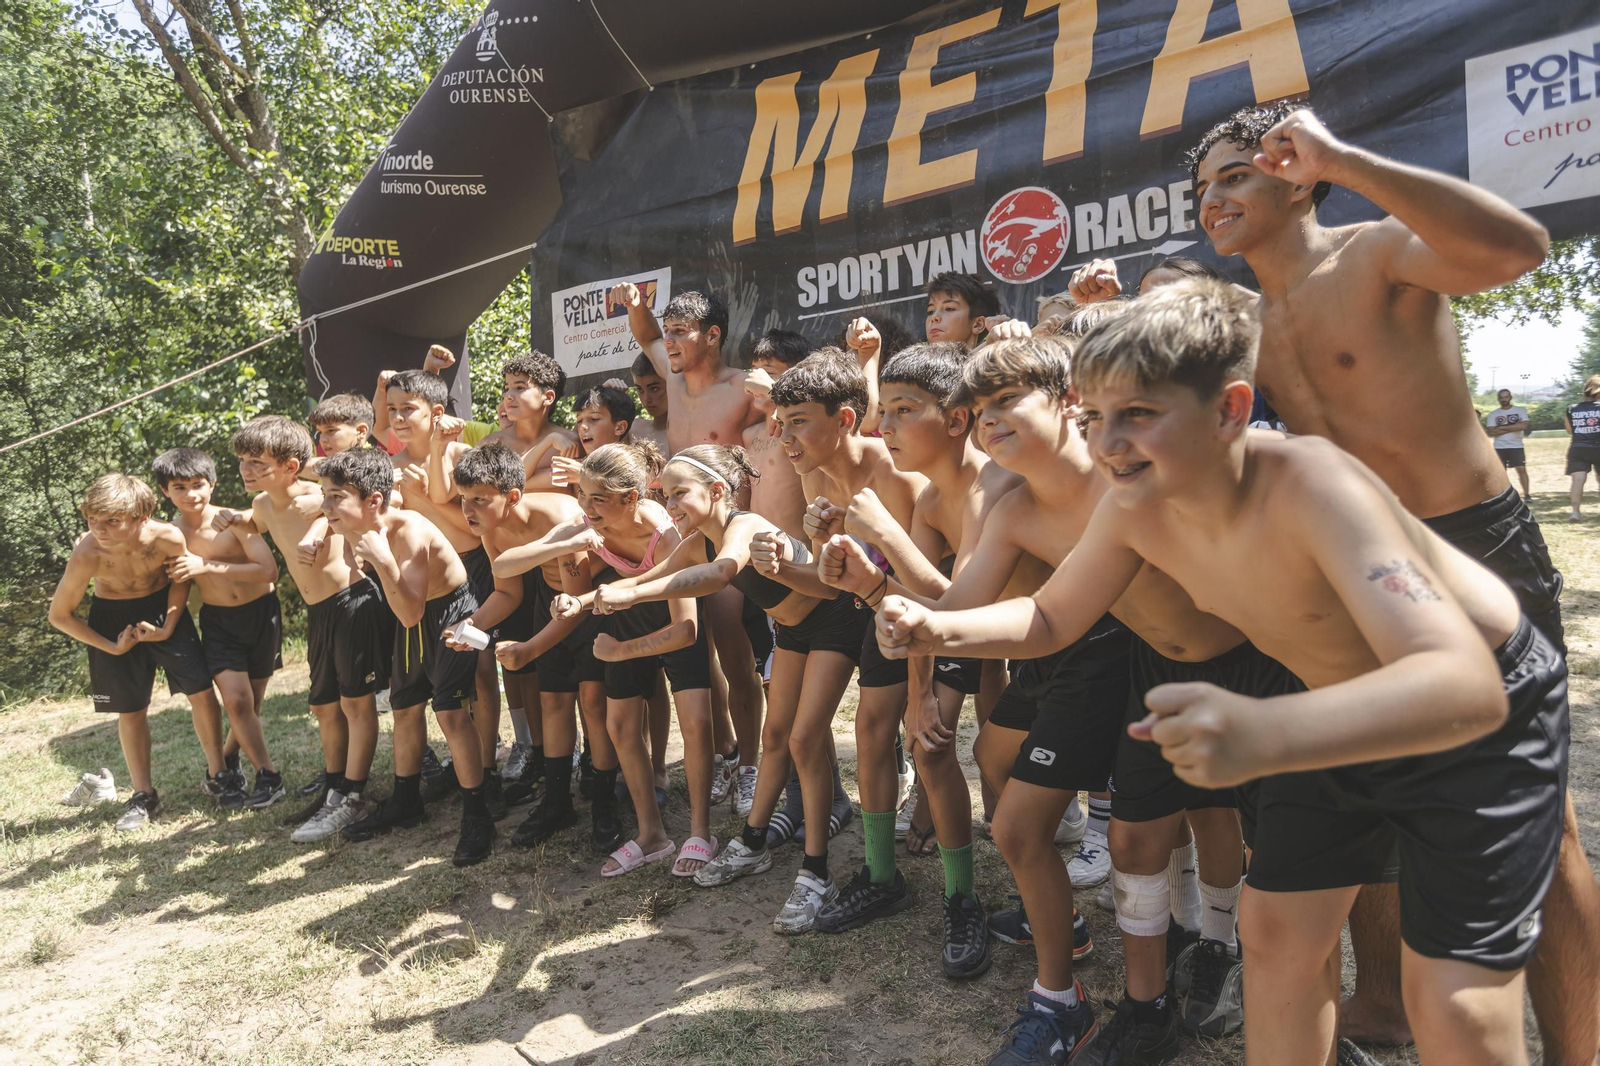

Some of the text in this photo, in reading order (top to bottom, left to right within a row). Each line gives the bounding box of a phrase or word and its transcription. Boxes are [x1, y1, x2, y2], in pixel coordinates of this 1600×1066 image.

[441, 64, 544, 87] DEPUTACIÓN
[449, 87, 531, 104] OURENSE
[732, 0, 1310, 247] META
[1504, 118, 1592, 147] Centro
[380, 180, 487, 196] turismo Ourense
[797, 179, 1196, 308] SPORTYAN RACE
[341, 253, 358, 266] La
[563, 289, 604, 313] PONTE
[564, 308, 605, 328] VELLA
[563, 322, 627, 345] Centro Comercial
[575, 341, 611, 368] parte
[612, 340, 625, 355] de
